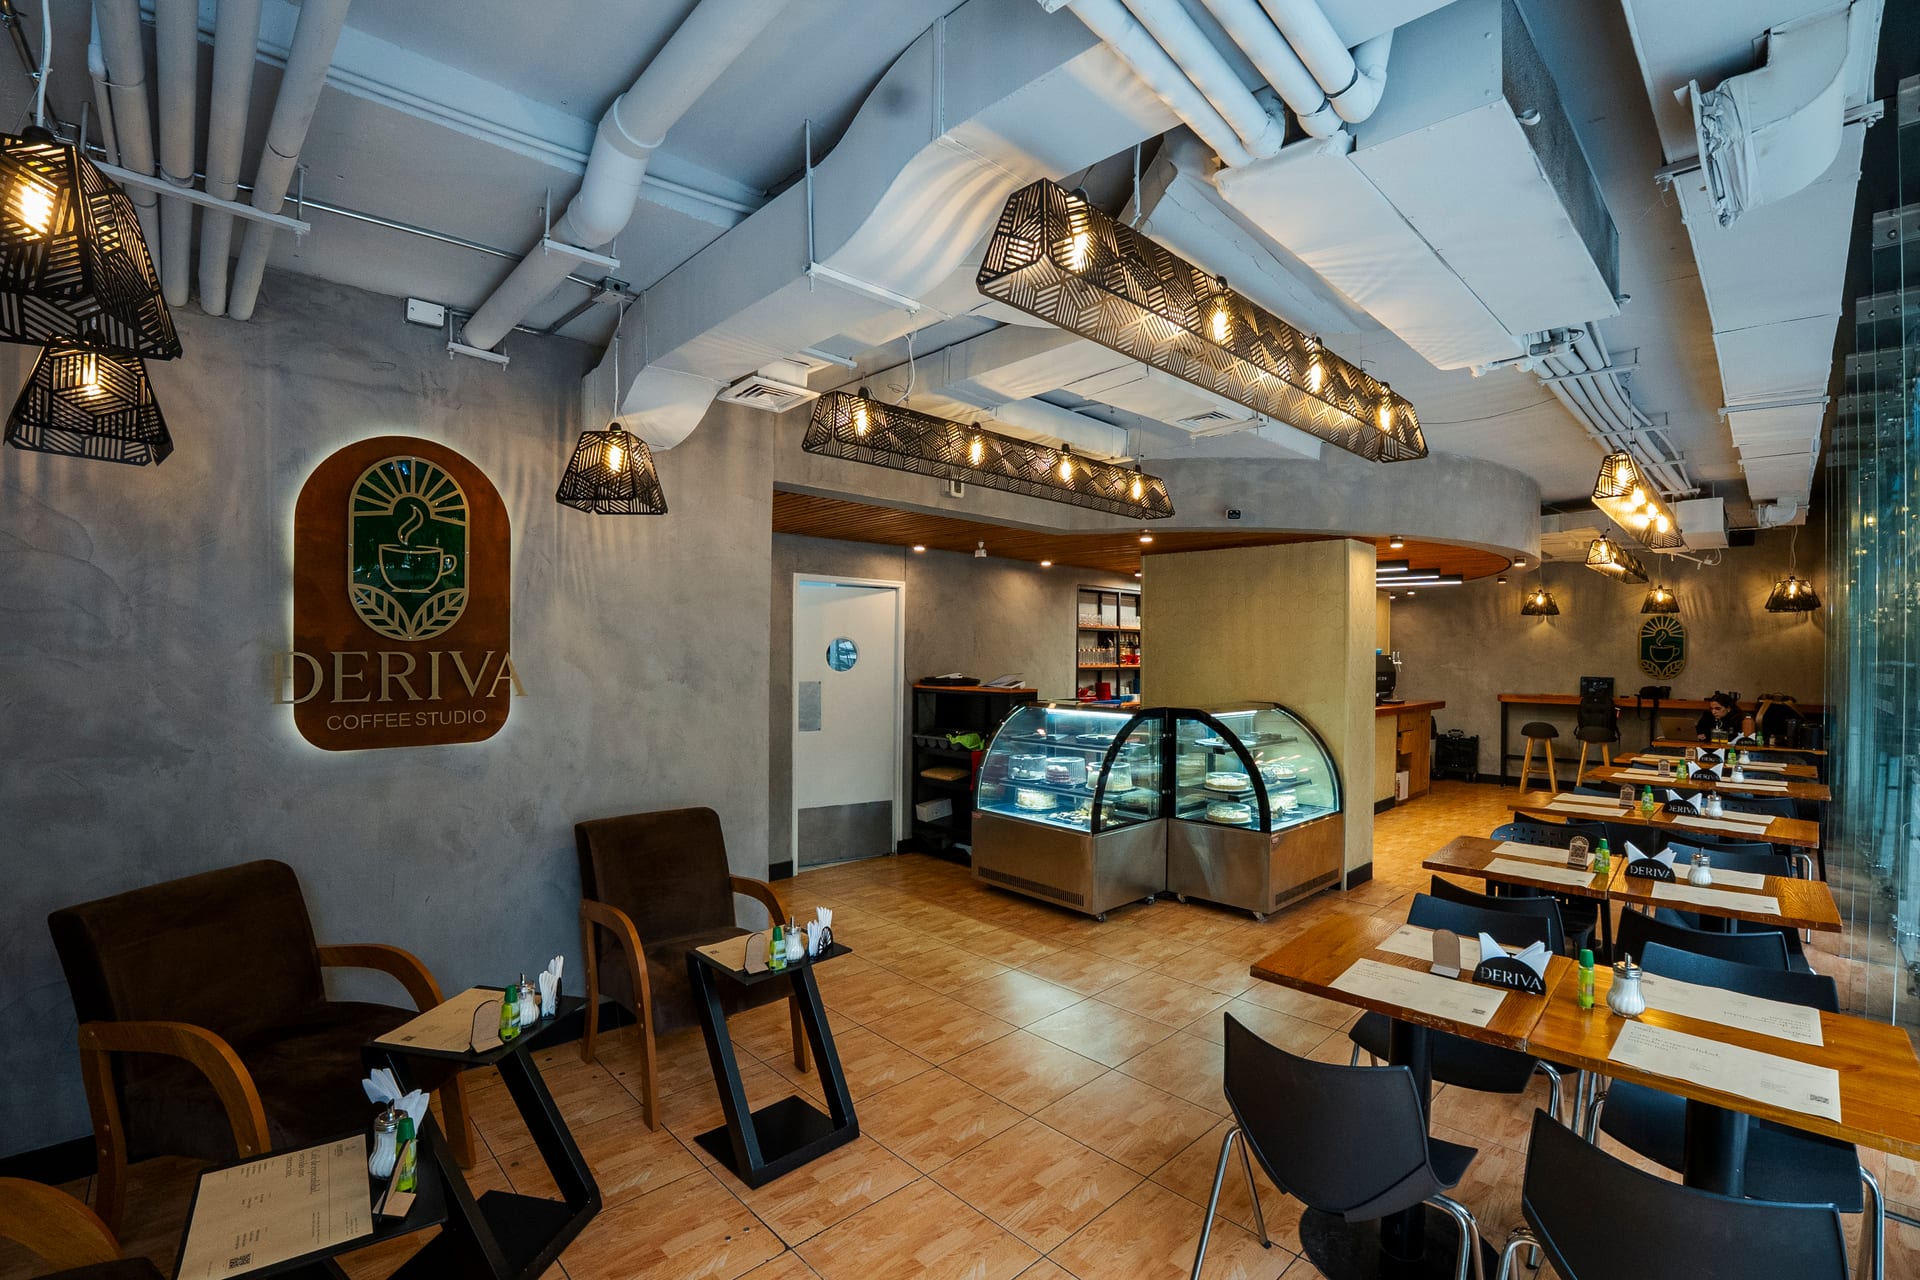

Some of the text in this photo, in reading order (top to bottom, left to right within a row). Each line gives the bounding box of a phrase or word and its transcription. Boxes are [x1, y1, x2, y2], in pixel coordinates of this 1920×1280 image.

[272, 650, 528, 705] DERIVA
[326, 709, 486, 730] COFFEE STUDIO
[1480, 966, 1542, 991] DERIVA
